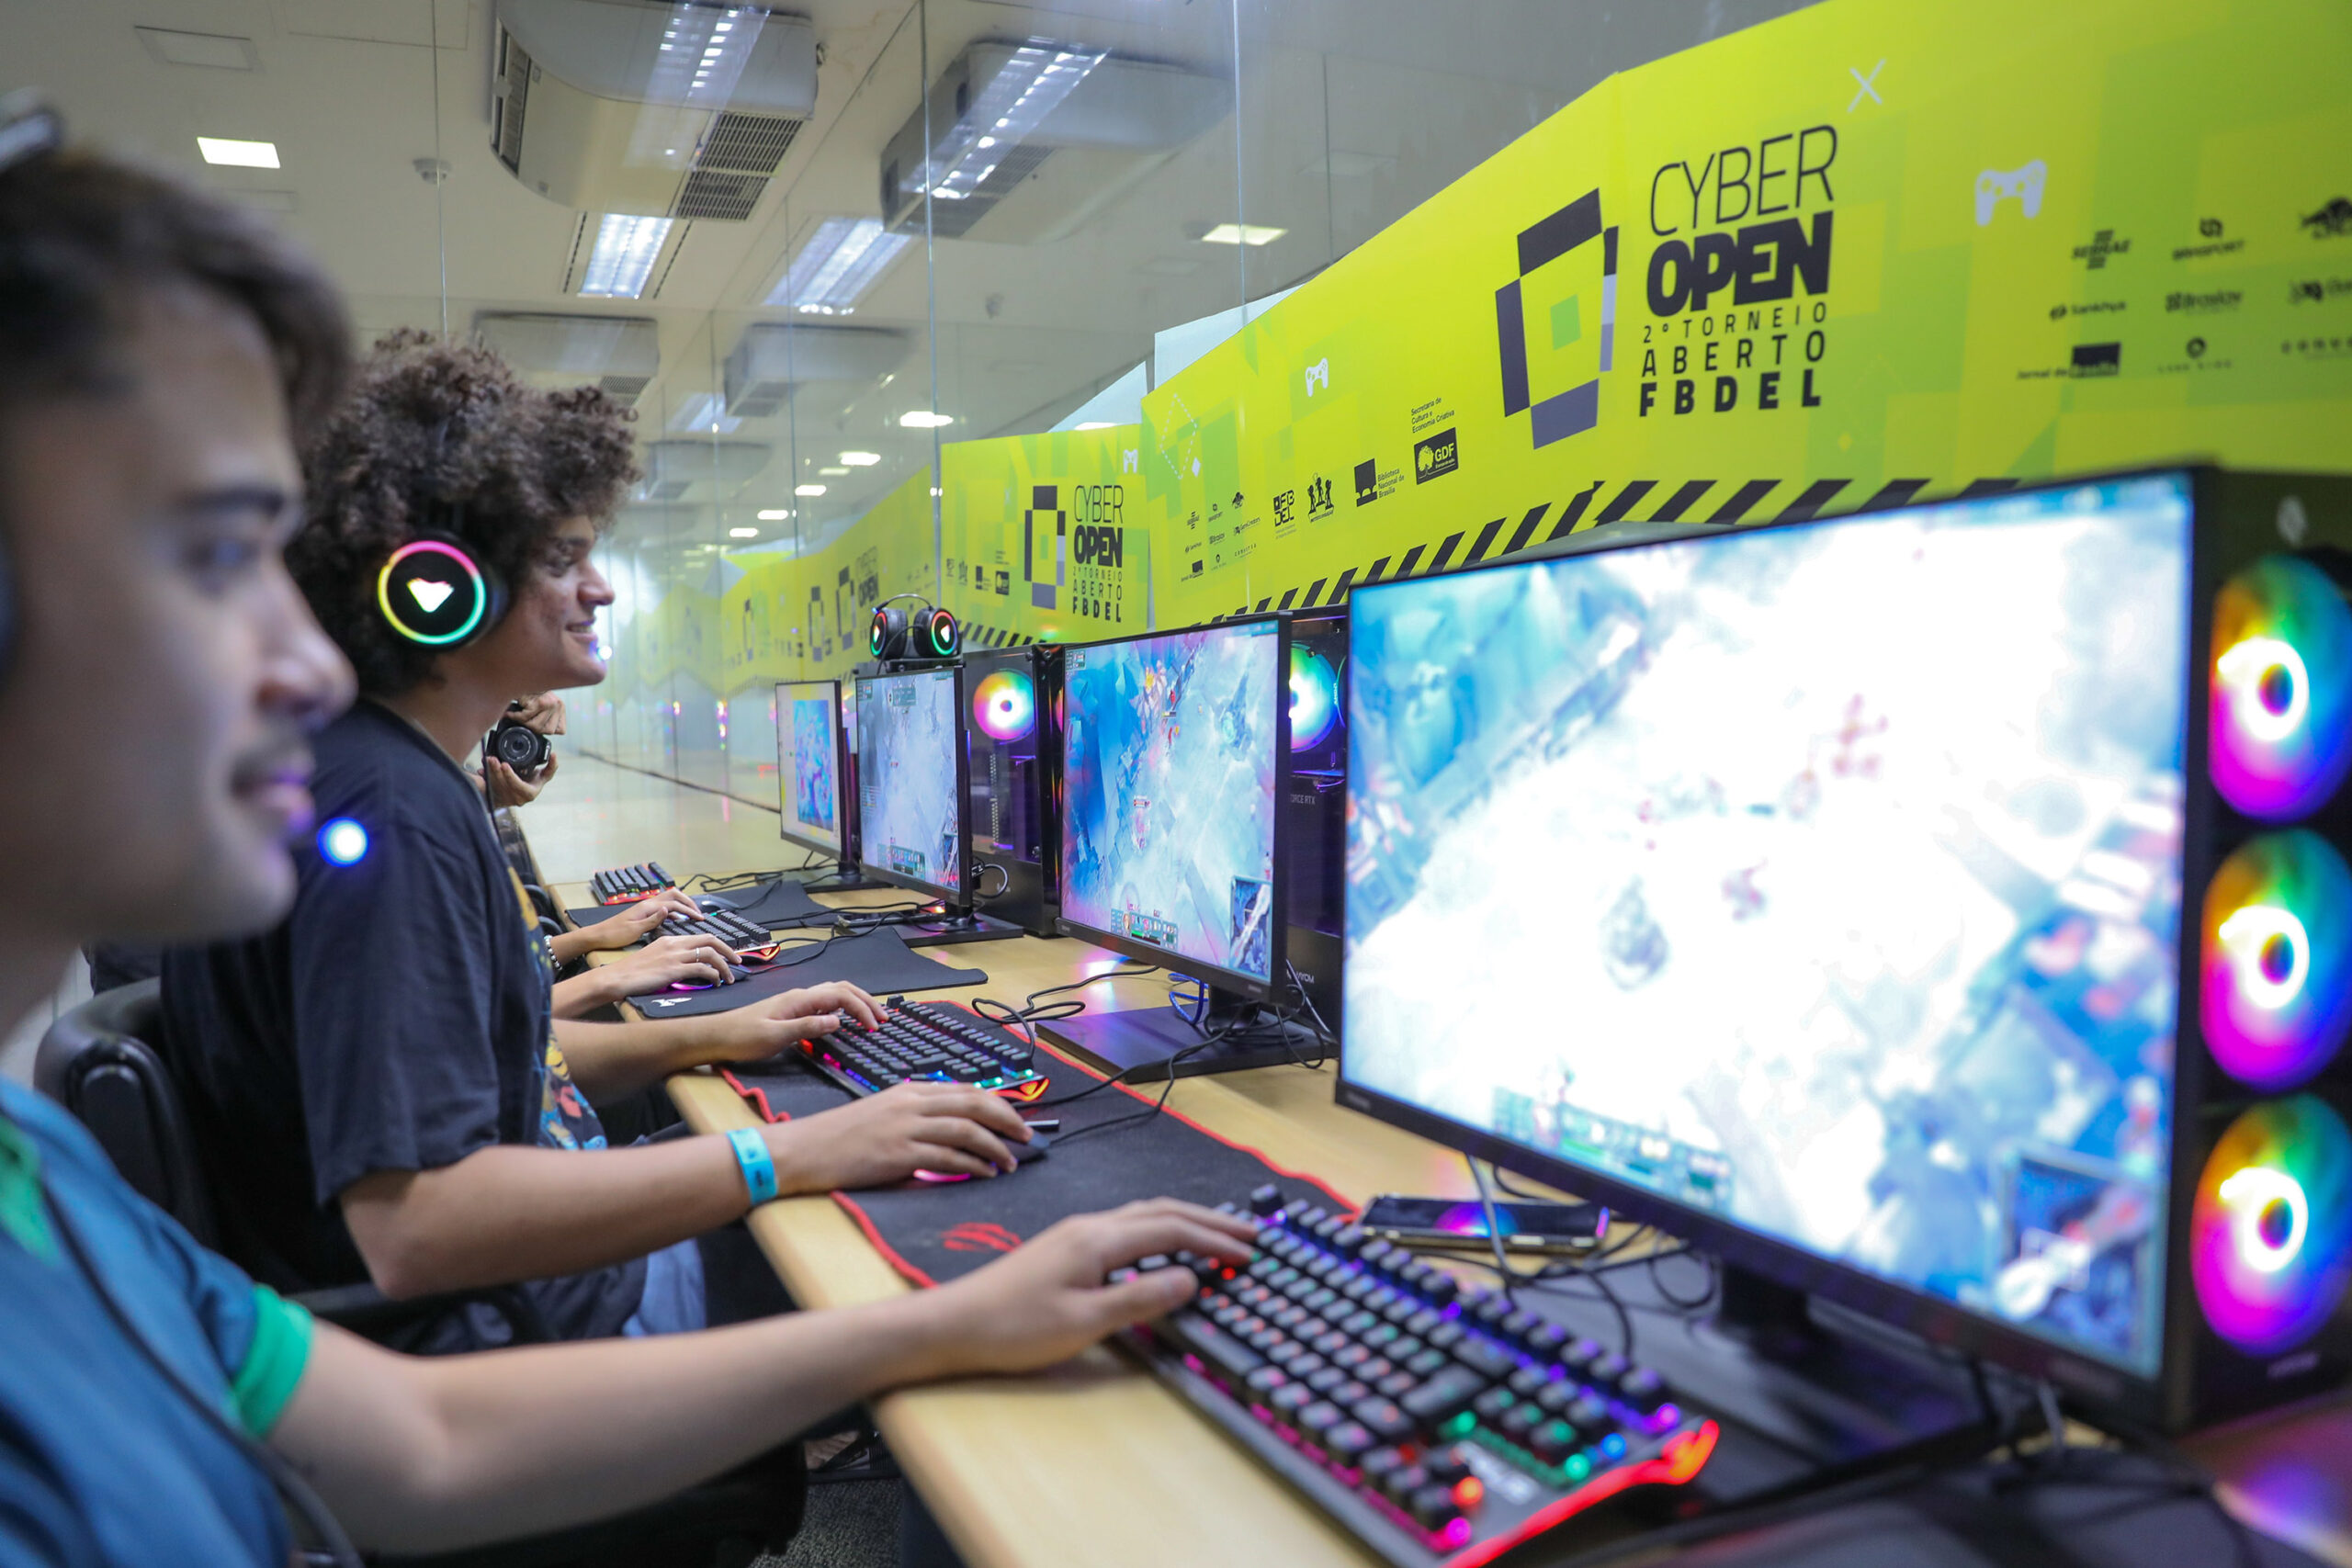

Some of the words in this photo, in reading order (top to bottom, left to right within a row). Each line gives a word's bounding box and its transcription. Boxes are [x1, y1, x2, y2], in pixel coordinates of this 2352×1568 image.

[1650, 125, 1838, 237] CYBER
[1645, 209, 1834, 318] OPEN
[1682, 301, 1827, 339] TORNEIO
[1641, 330, 1826, 378] ABERTO
[1639, 368, 1822, 417] FBDEL
[1411, 412, 1429, 424] Cultura
[1434, 442, 1454, 462] GDF
[1073, 484, 1125, 524] CYBER
[1073, 524, 1124, 569] OPEN
[1073, 578, 1123, 601] ABERTO
[1072, 596, 1122, 624] FBDEL
